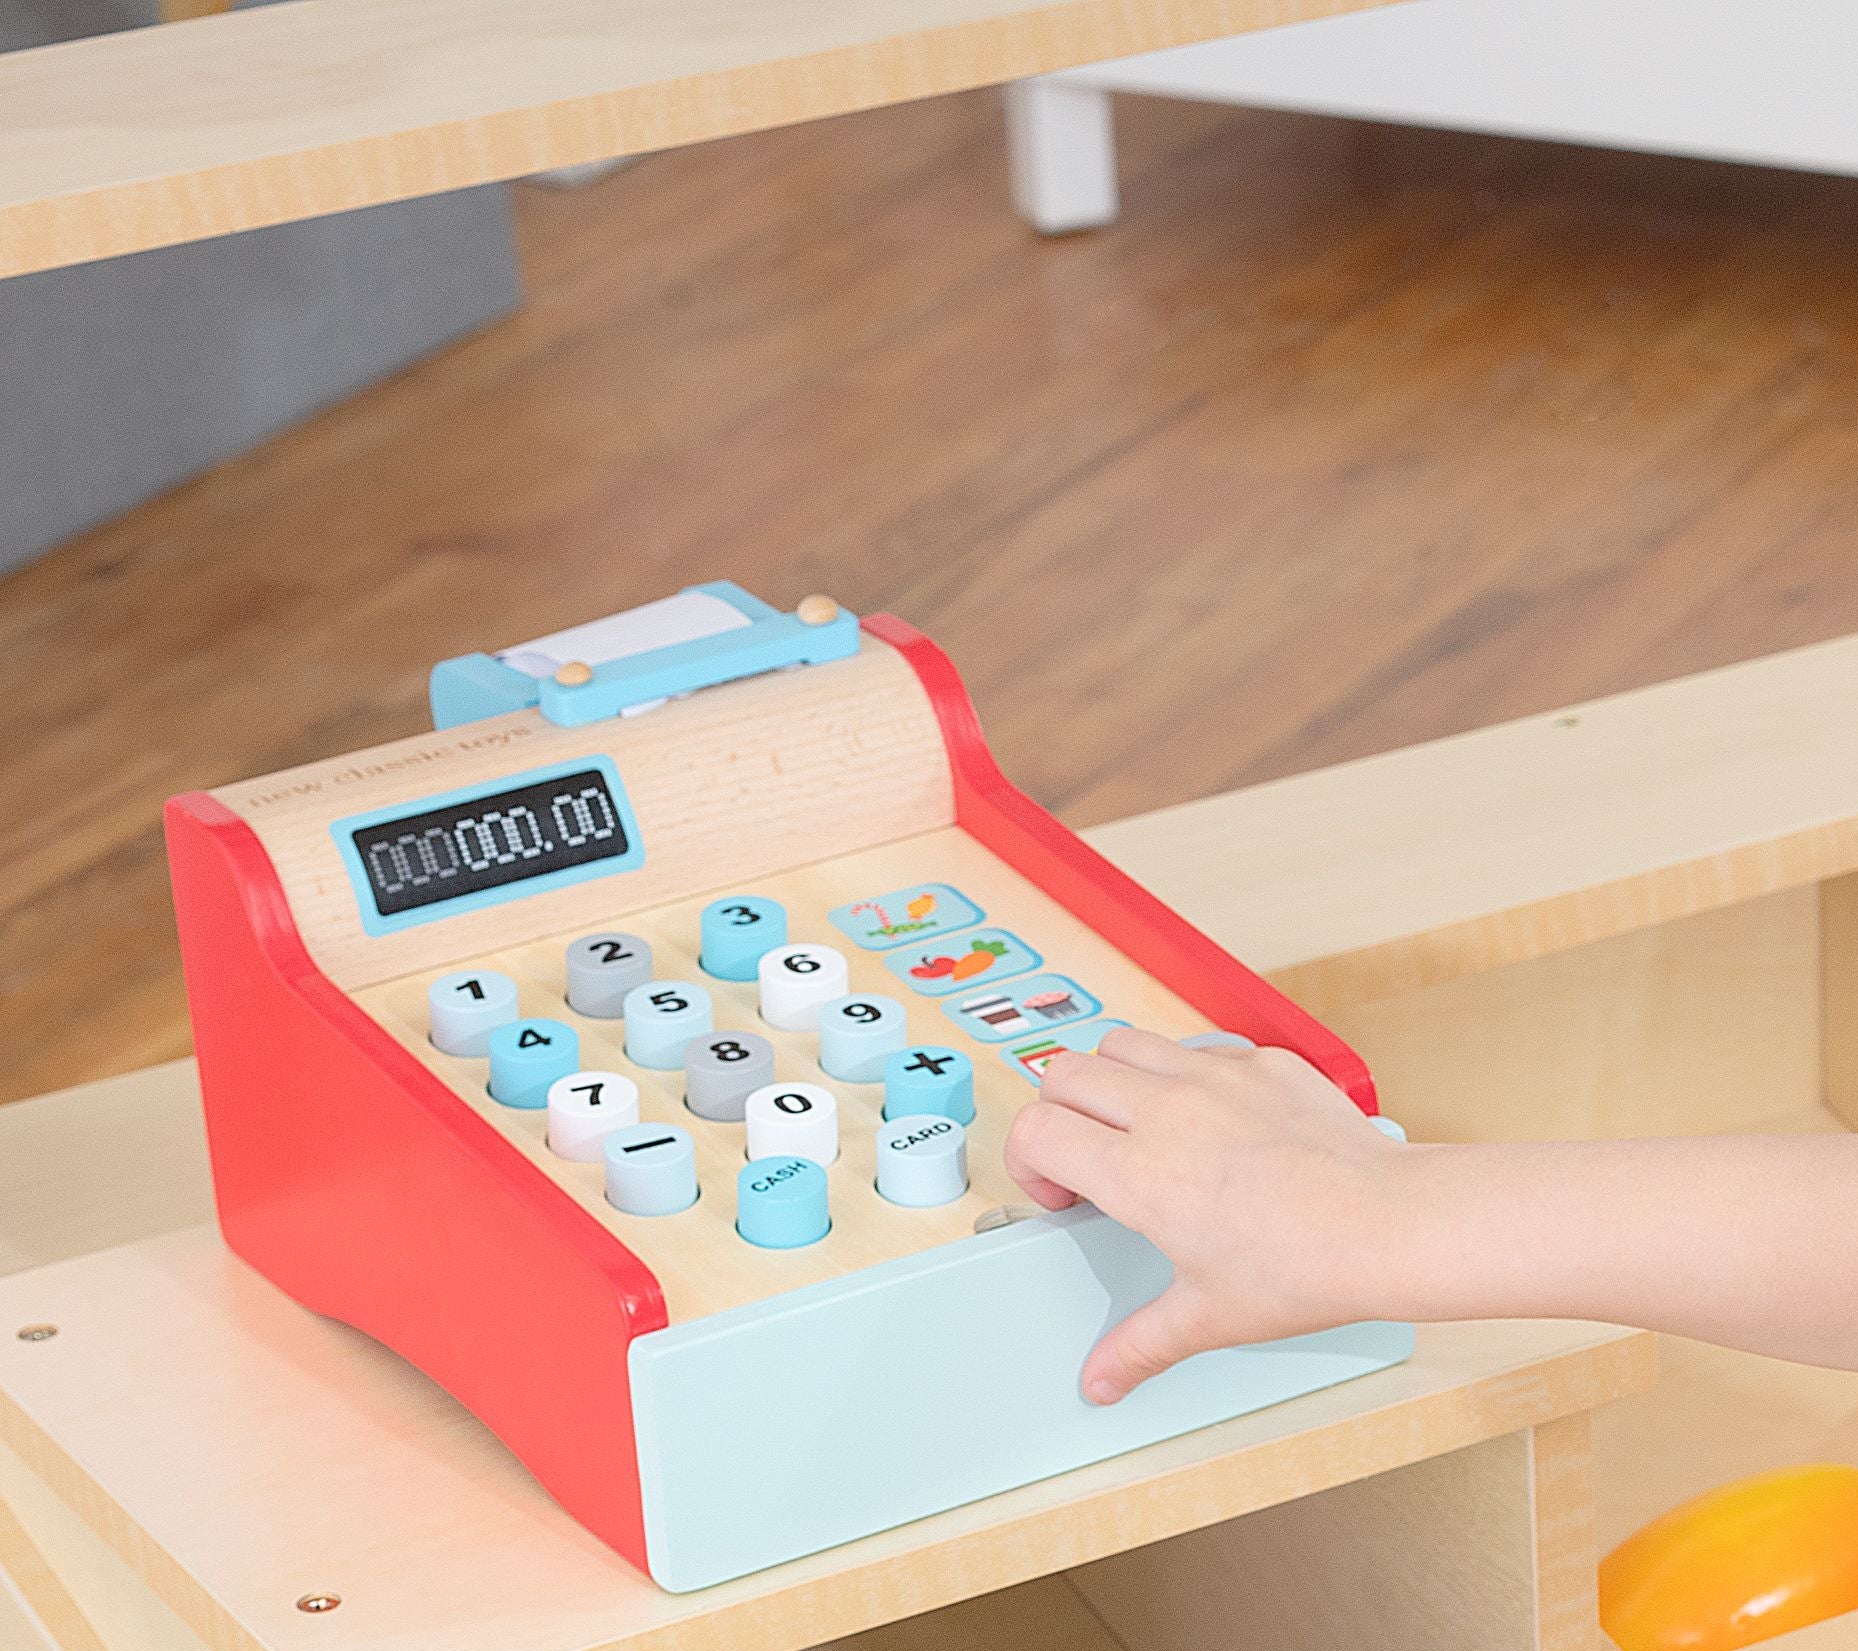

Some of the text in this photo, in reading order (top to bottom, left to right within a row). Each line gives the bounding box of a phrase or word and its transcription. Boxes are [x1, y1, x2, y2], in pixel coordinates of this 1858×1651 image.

[249, 725, 533, 807] new classic toys
[722, 905, 761, 926] 3
[588, 940, 634, 964] 2
[783, 953, 821, 974] 6
[456, 979, 485, 1000] 1
[650, 990, 689, 1013] 5
[842, 1002, 882, 1024] 9
[518, 1029, 552, 1049] 4
[709, 1040, 750, 1062] 8
[571, 1082, 604, 1106] 7
[774, 1093, 812, 1114] 0
[890, 1121, 953, 1151] CARD
[750, 1160, 808, 1192] CASH
